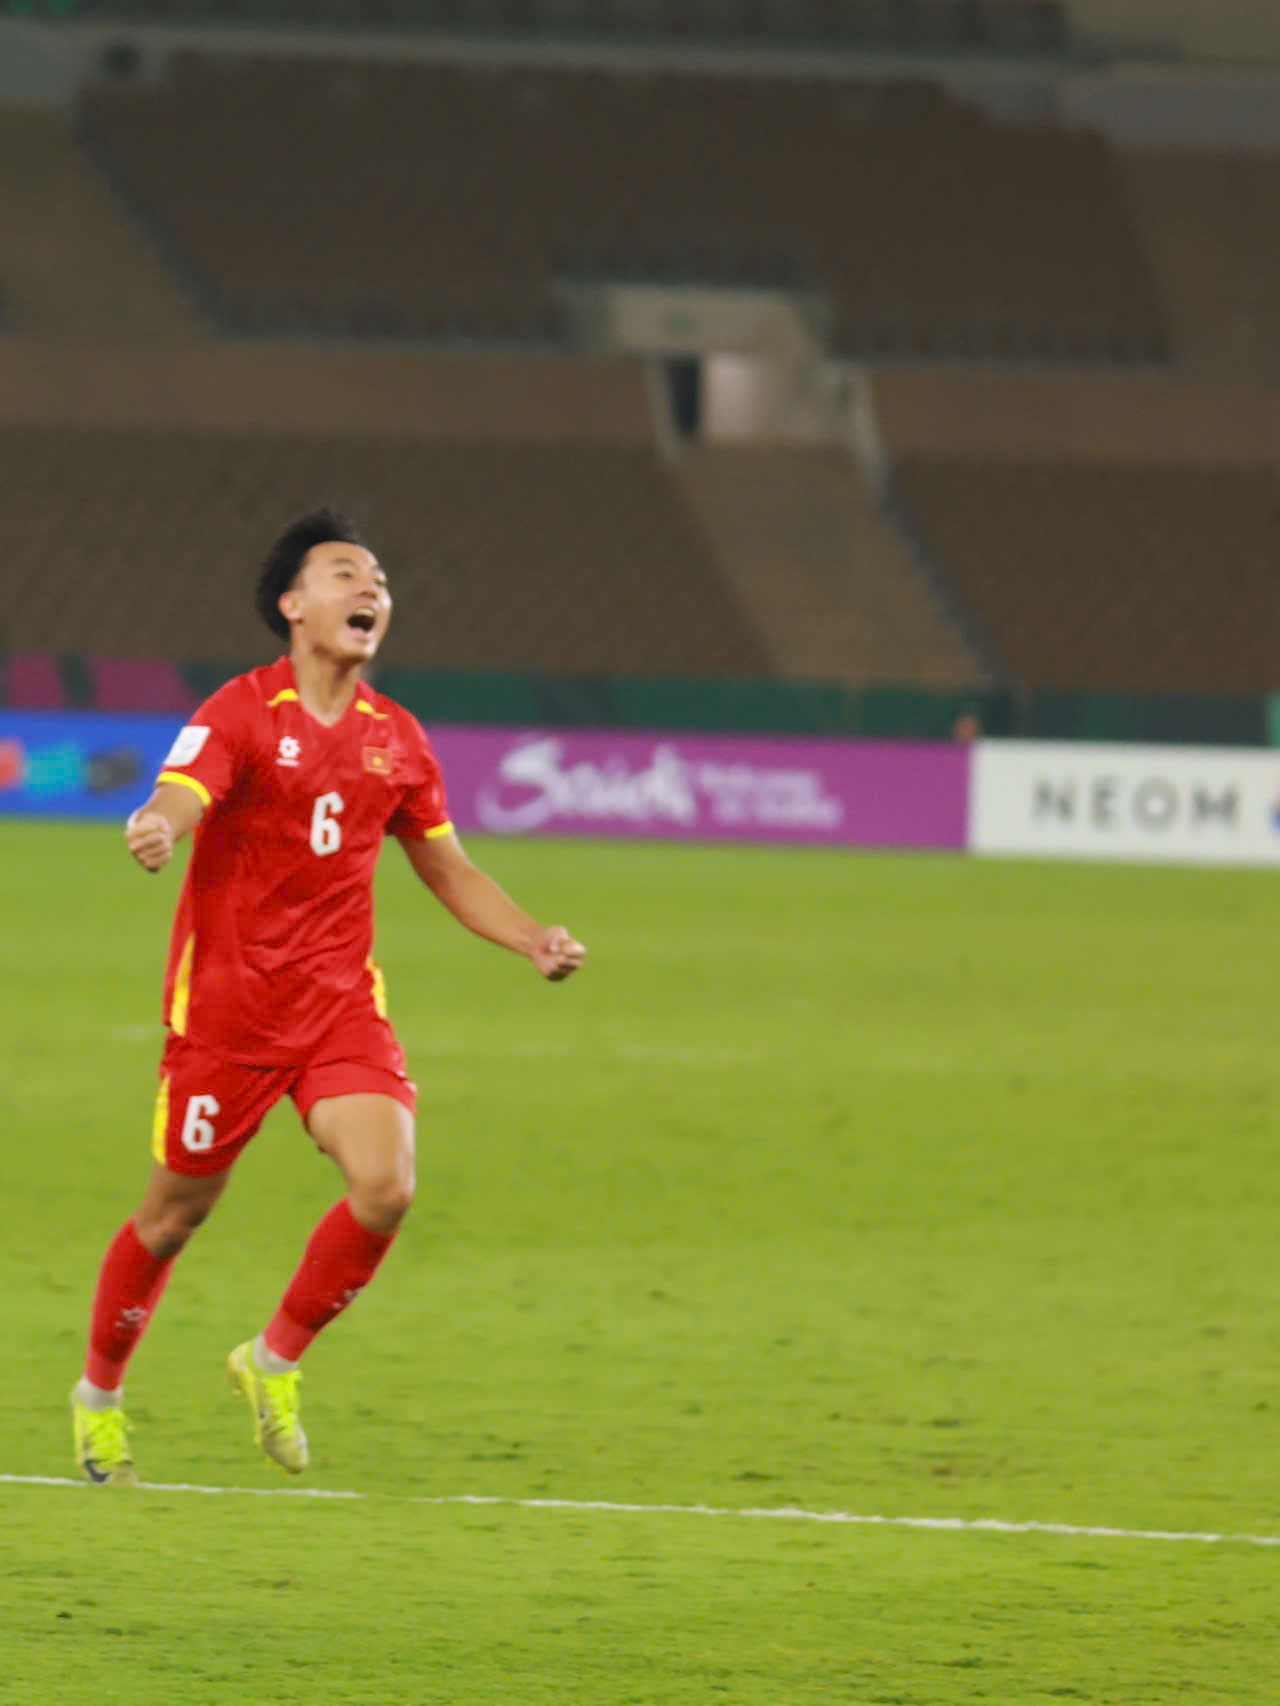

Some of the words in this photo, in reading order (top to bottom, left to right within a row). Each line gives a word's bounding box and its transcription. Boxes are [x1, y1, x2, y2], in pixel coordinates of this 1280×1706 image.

[309, 791, 344, 857] 6
[1031, 775, 1241, 833] NEOM
[181, 1094, 221, 1153] 6
